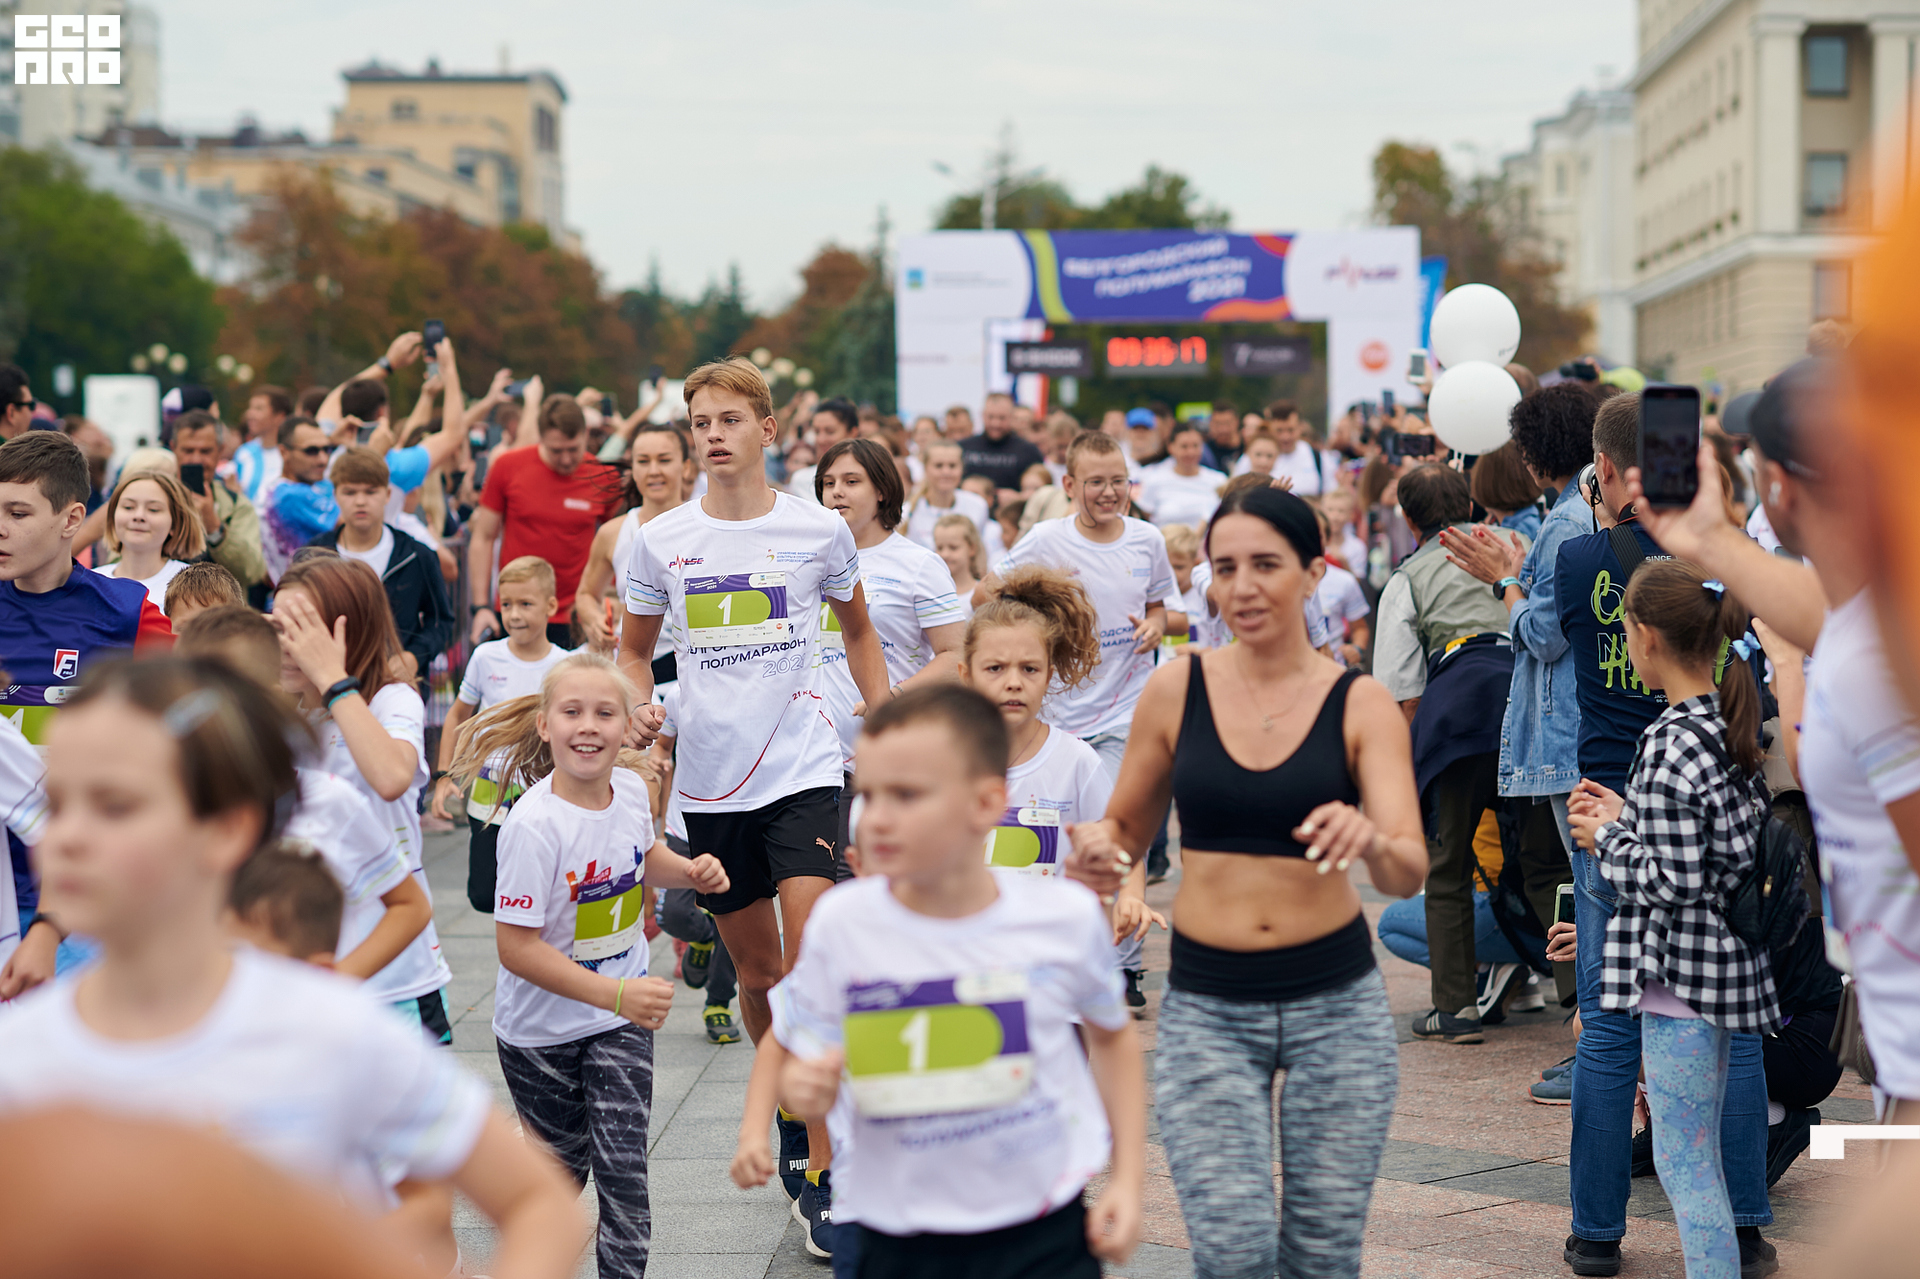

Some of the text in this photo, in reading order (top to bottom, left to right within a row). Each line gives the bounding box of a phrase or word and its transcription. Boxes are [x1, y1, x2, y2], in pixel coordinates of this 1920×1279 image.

[1645, 555, 1672, 563] SINCE
[717, 594, 732, 625] 1
[700, 637, 807, 670] ПОЛУМАРАФОН
[609, 896, 624, 932] 1
[898, 1009, 931, 1073] 1
[789, 1158, 810, 1171] PUM
